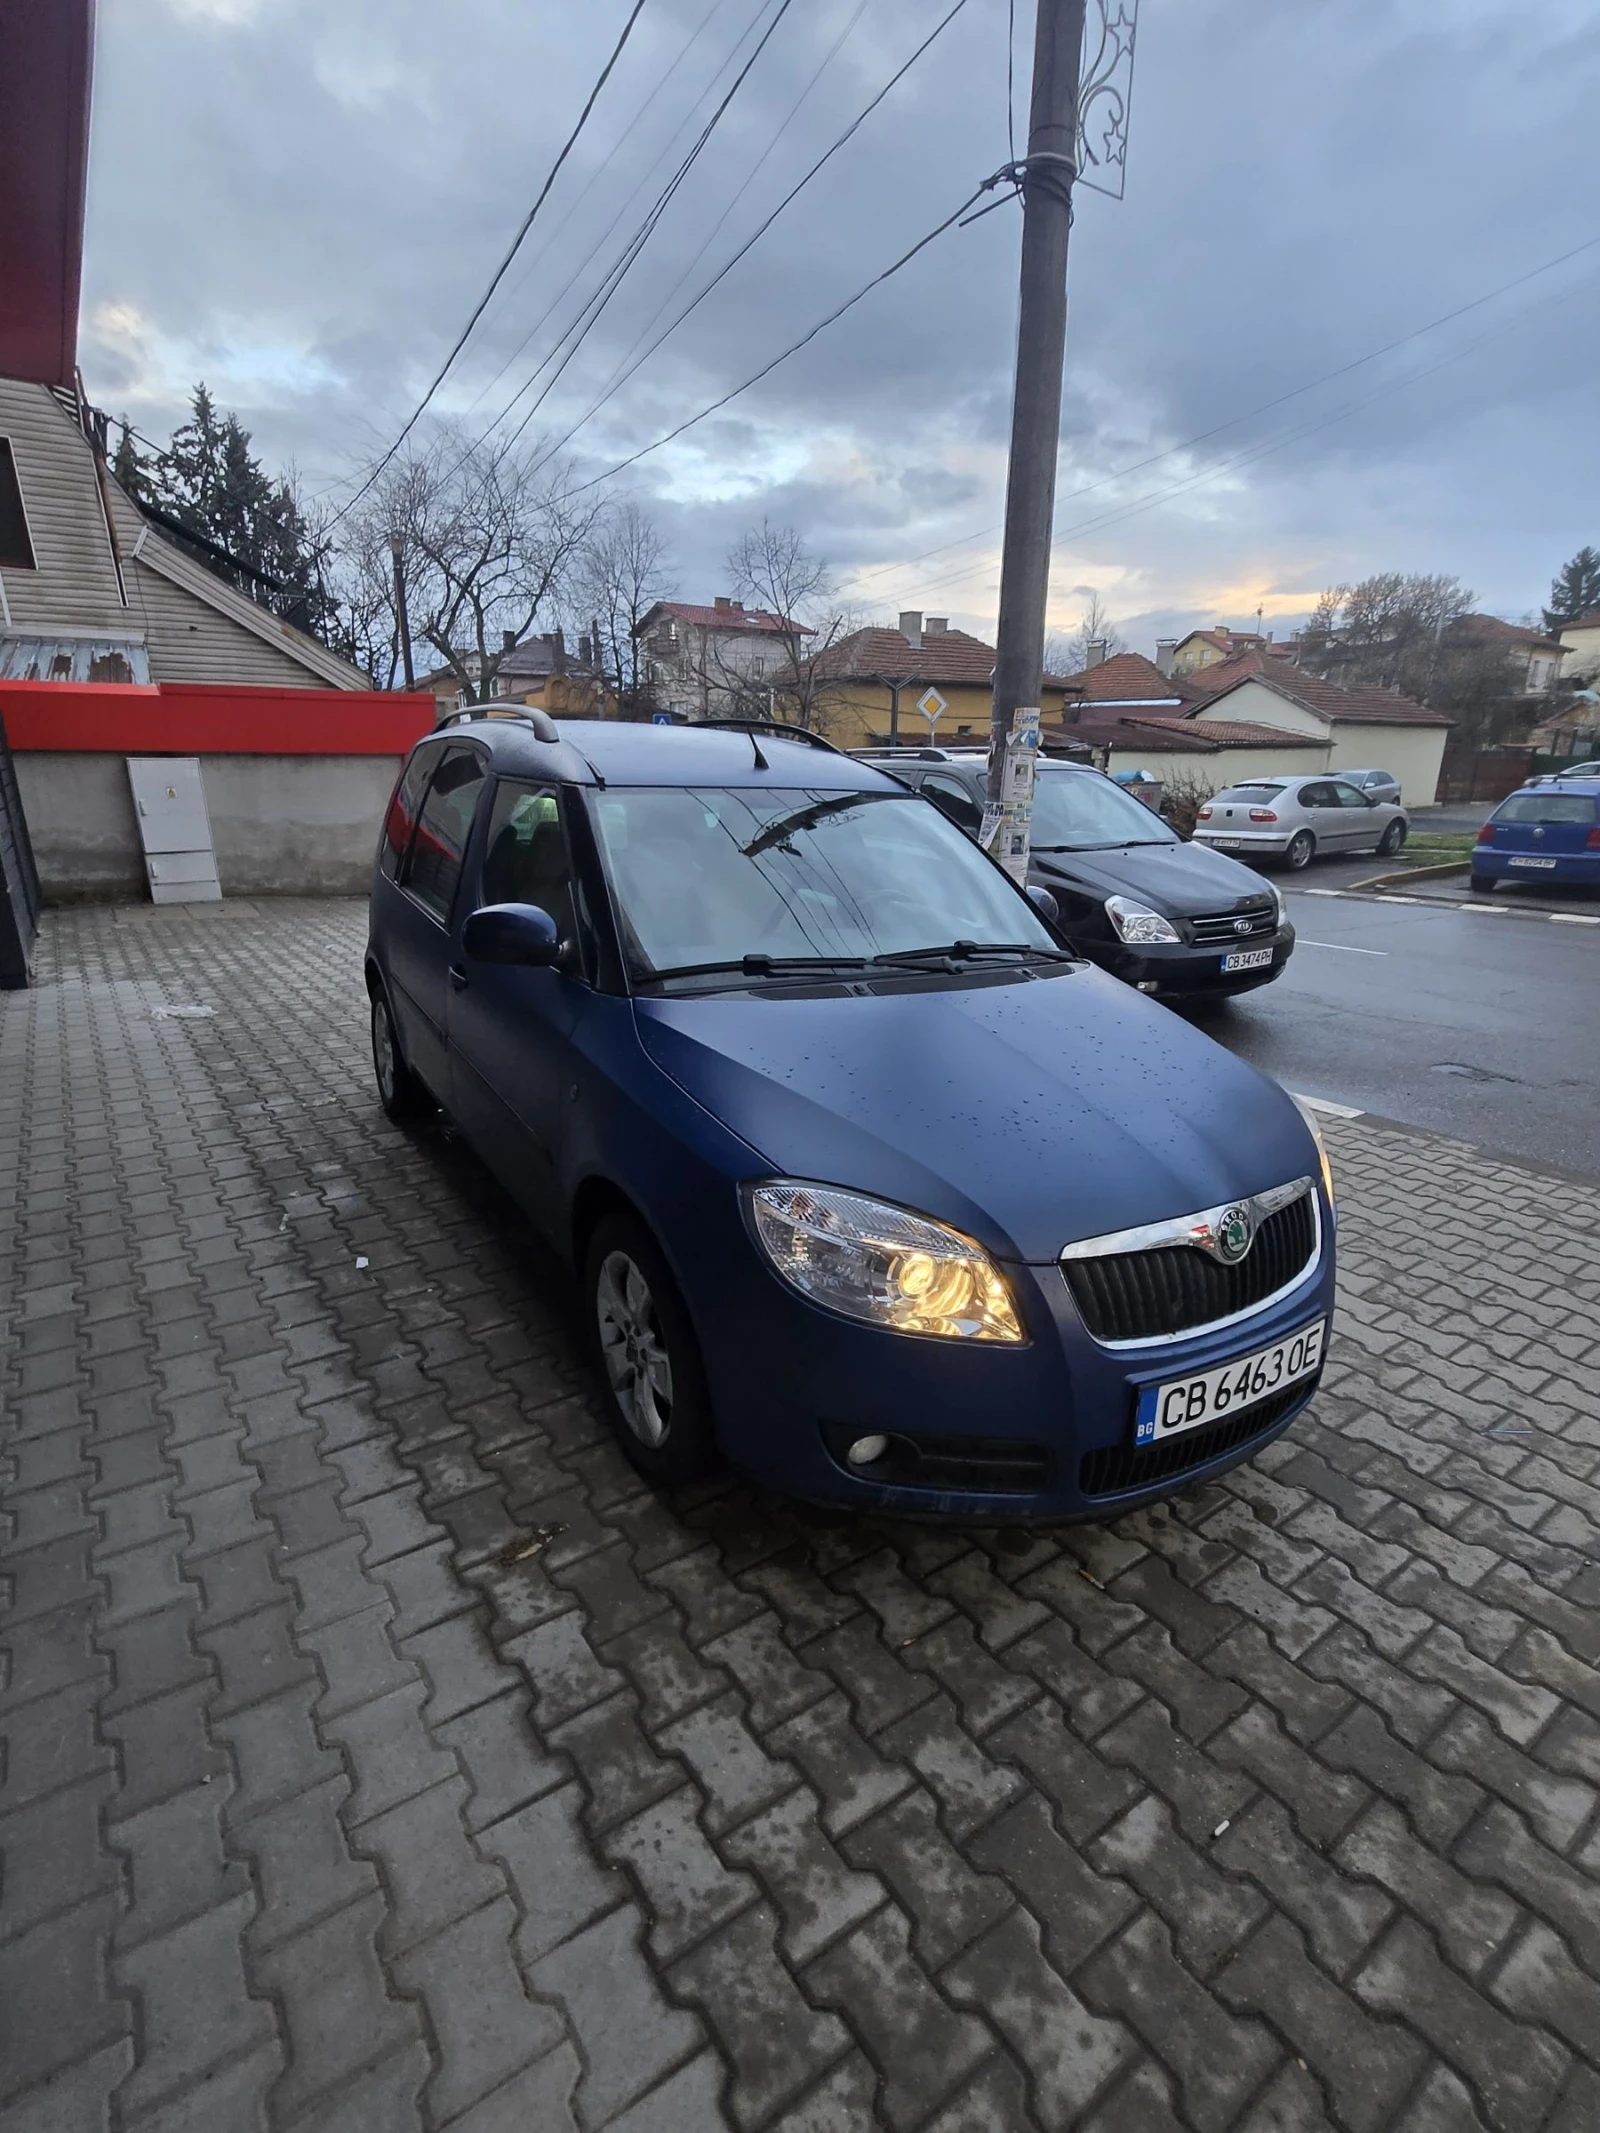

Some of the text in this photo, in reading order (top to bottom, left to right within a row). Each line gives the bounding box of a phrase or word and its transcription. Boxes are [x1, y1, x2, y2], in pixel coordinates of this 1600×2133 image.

[1227, 955, 1240, 969] CB
[1240, 952, 1261, 967] 3474
[1161, 1380, 1207, 1429] CB
[1214, 1348, 1284, 1411] 6463
[1137, 1422, 1153, 1437] BG
